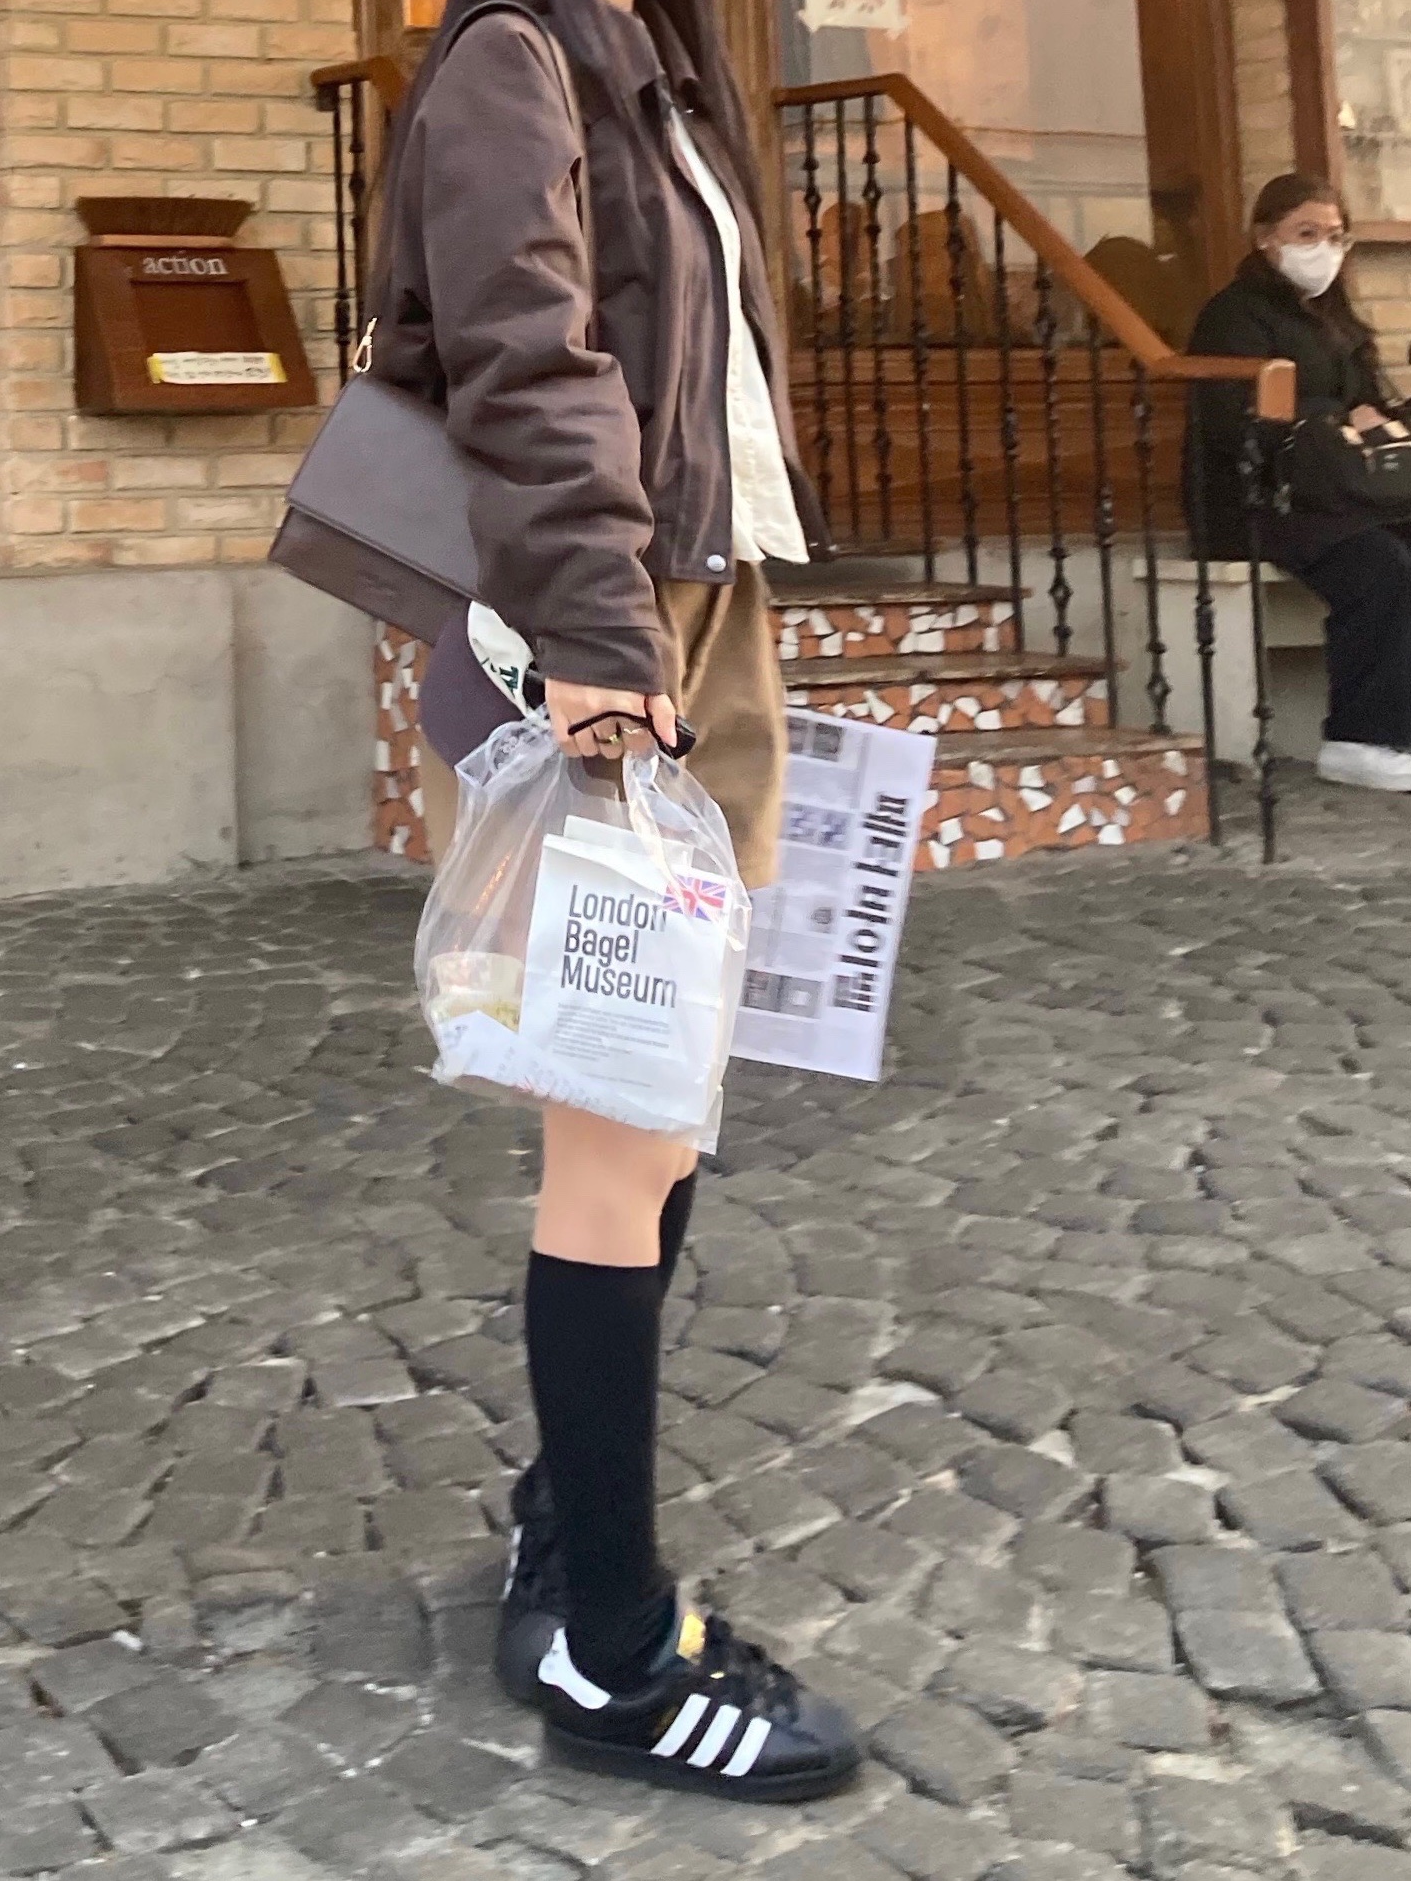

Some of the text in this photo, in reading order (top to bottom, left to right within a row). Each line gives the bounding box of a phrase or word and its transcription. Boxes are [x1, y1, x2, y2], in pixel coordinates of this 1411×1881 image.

[568, 884, 668, 932] London
[564, 919, 639, 968] Bagel
[560, 955, 677, 1009] Museum
